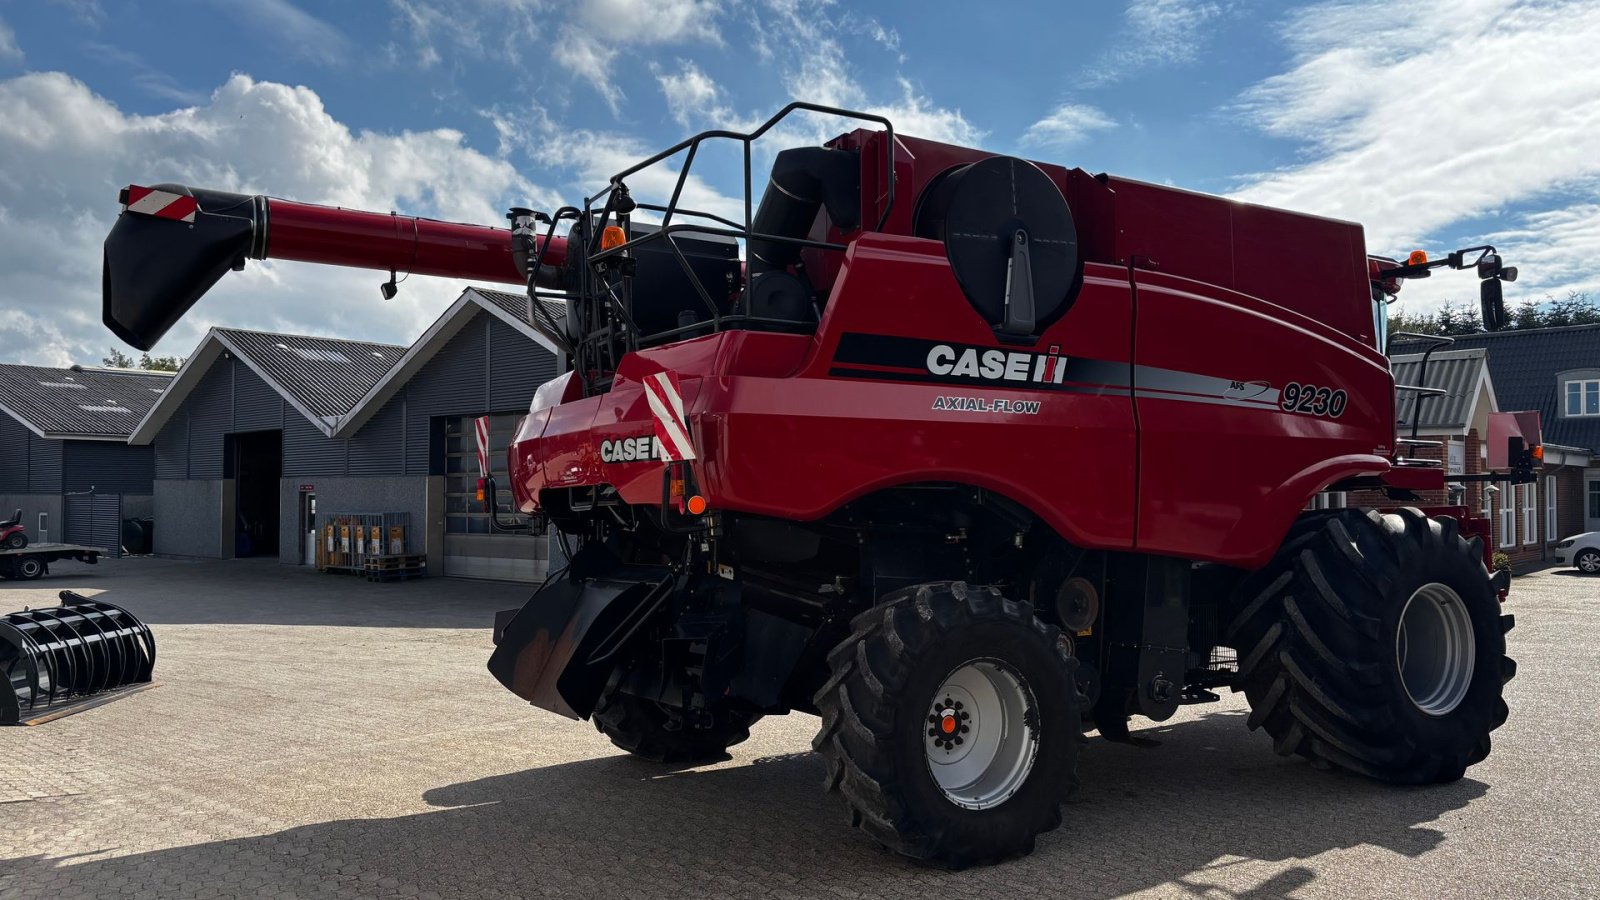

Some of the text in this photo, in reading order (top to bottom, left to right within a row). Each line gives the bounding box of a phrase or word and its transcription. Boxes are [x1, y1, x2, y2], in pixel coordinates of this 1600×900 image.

[926, 344, 1032, 381] CASE
[1230, 381, 1245, 391] AFS
[932, 396, 1041, 414] AXIAL-FLOW
[1281, 382, 1348, 419] 9230
[601, 437, 650, 463] CASE
